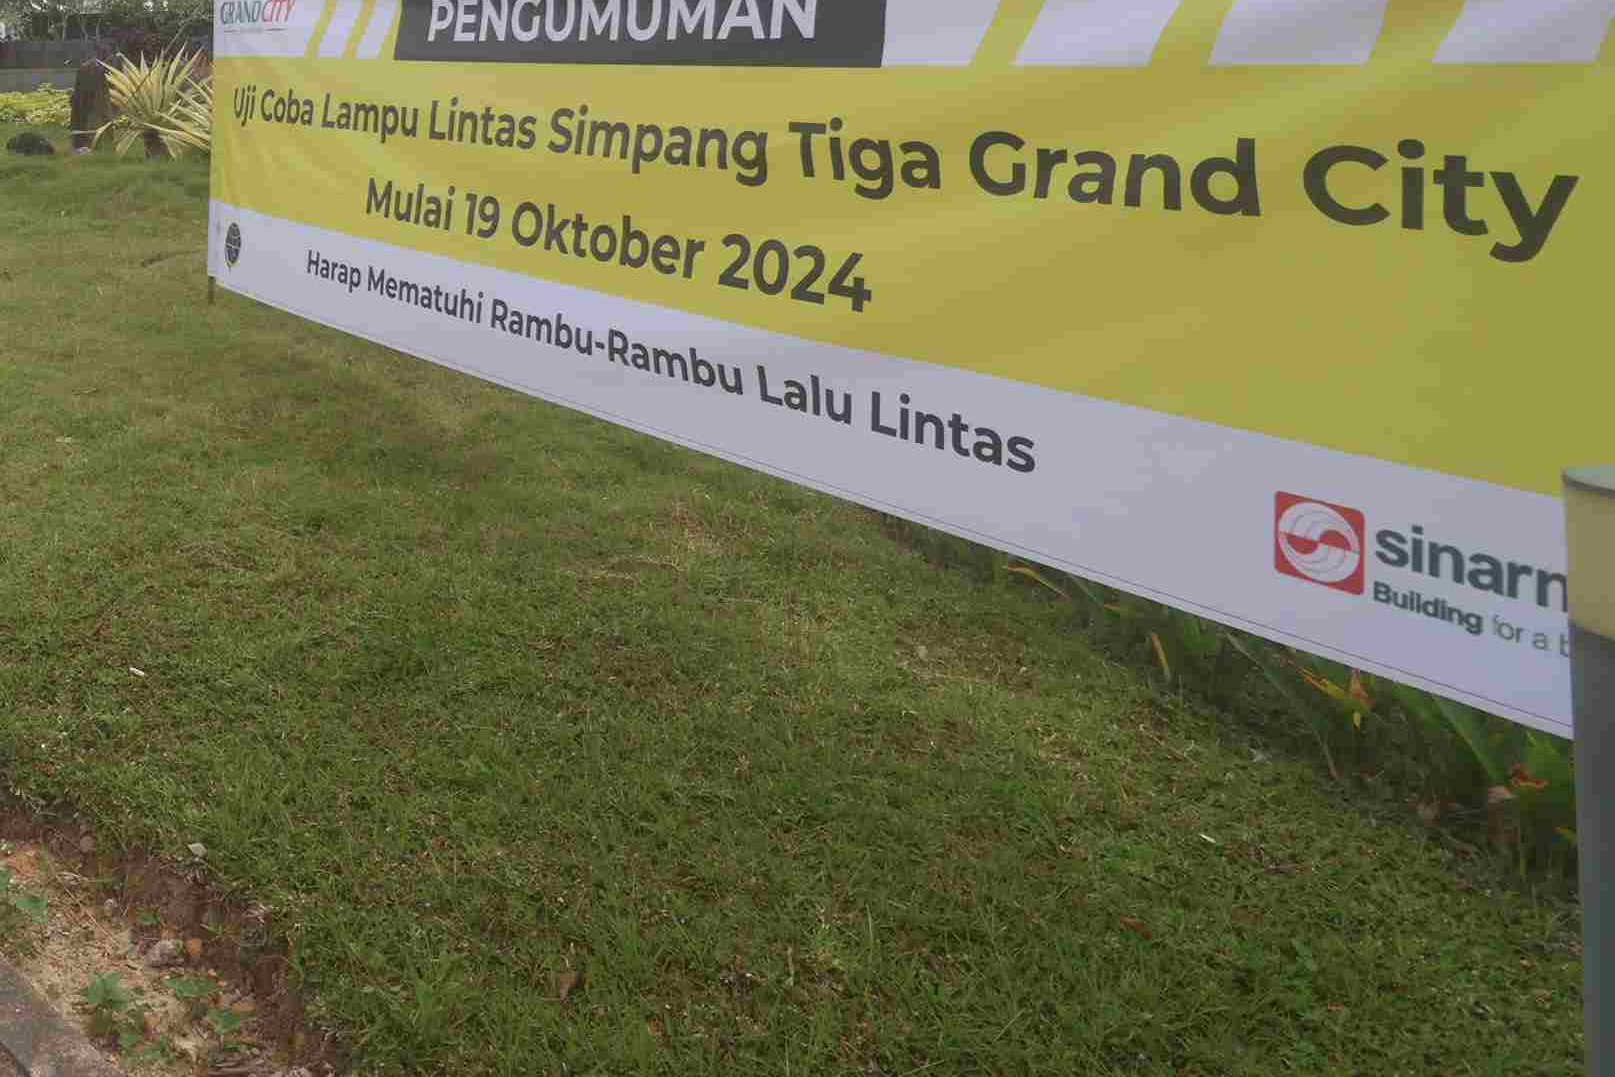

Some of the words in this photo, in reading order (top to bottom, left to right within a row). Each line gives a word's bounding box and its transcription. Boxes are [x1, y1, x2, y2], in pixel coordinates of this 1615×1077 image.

[234, 86, 256, 128] Uji
[260, 88, 314, 126] Coba
[321, 93, 419, 145] Lampu
[428, 96, 537, 150] Lintas
[547, 104, 769, 188] Simpang
[788, 116, 941, 201] Tiga
[968, 130, 1262, 218] Grand
[1302, 138, 1581, 264] City
[365, 177, 456, 231] Mulai
[465, 192, 500, 239] 19
[511, 200, 706, 280] Oktober
[717, 233, 873, 313] 2024
[307, 249, 362, 294] Harap
[367, 266, 482, 324] Mematuhi
[490, 298, 744, 396] Rambu-Rambu
[756, 364, 853, 426] Lalu
[870, 391, 1037, 473] Lintas
[1372, 580, 1485, 637] Building
[1492, 613, 1525, 643] for
[1532, 632, 1549, 652] a
